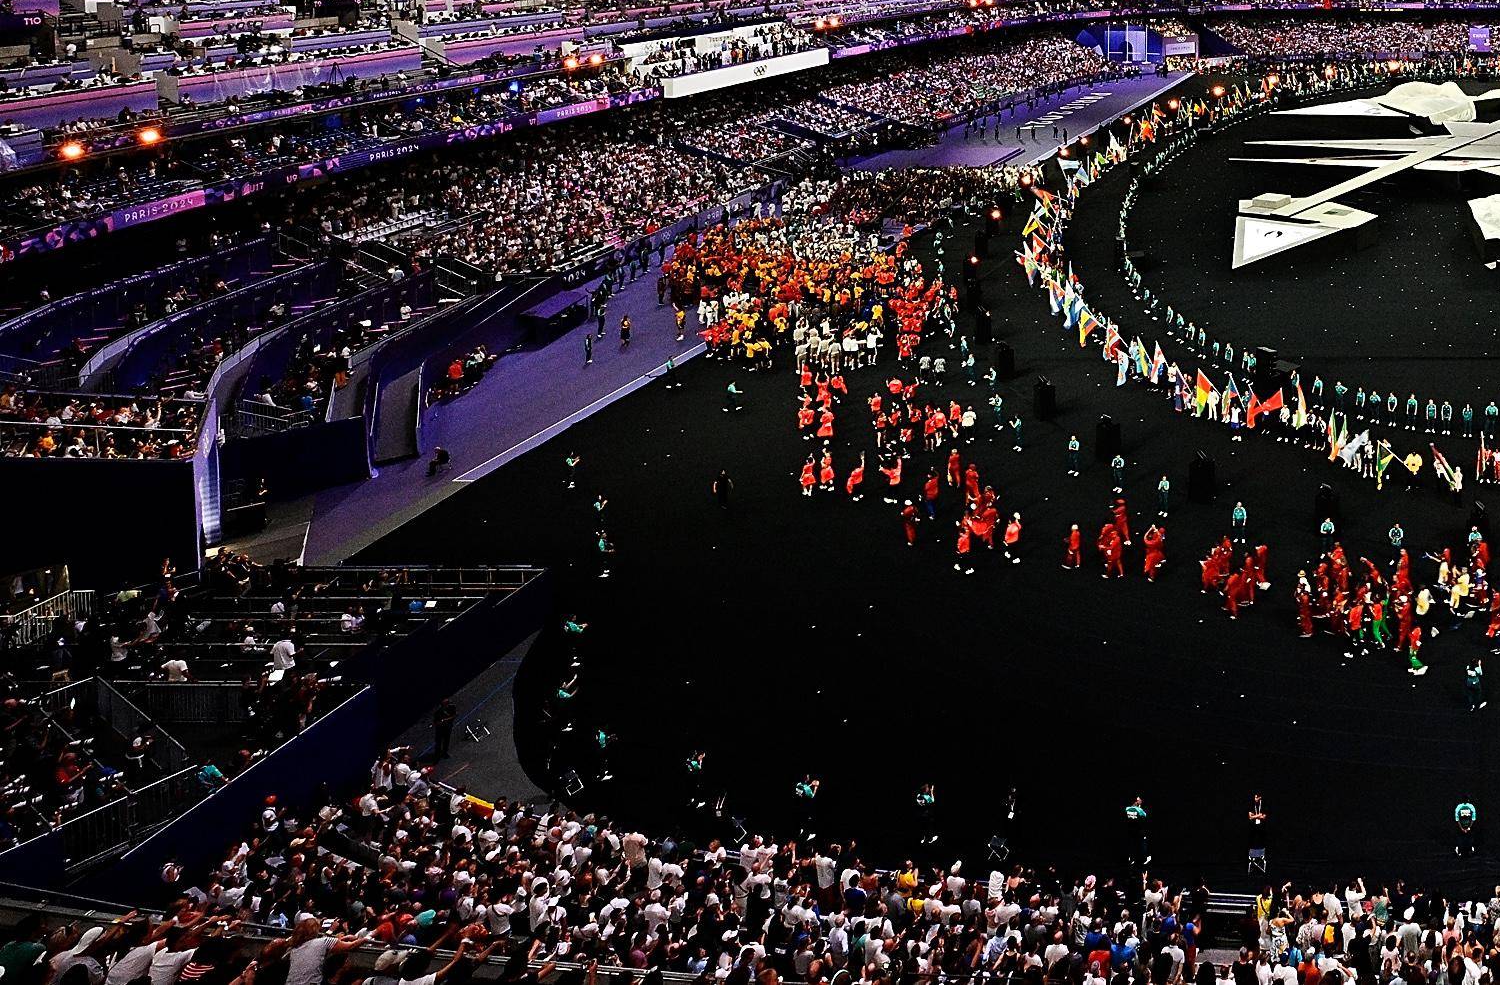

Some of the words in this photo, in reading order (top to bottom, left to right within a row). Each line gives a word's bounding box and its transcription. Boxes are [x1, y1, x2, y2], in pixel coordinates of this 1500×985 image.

[556, 109, 575, 117] PARIS
[369, 149, 394, 161] PARIS
[397, 144, 420, 155] 2024
[286, 174, 298, 183] U9
[124, 206, 157, 222] PARIS
[162, 197, 194, 213] 2024
